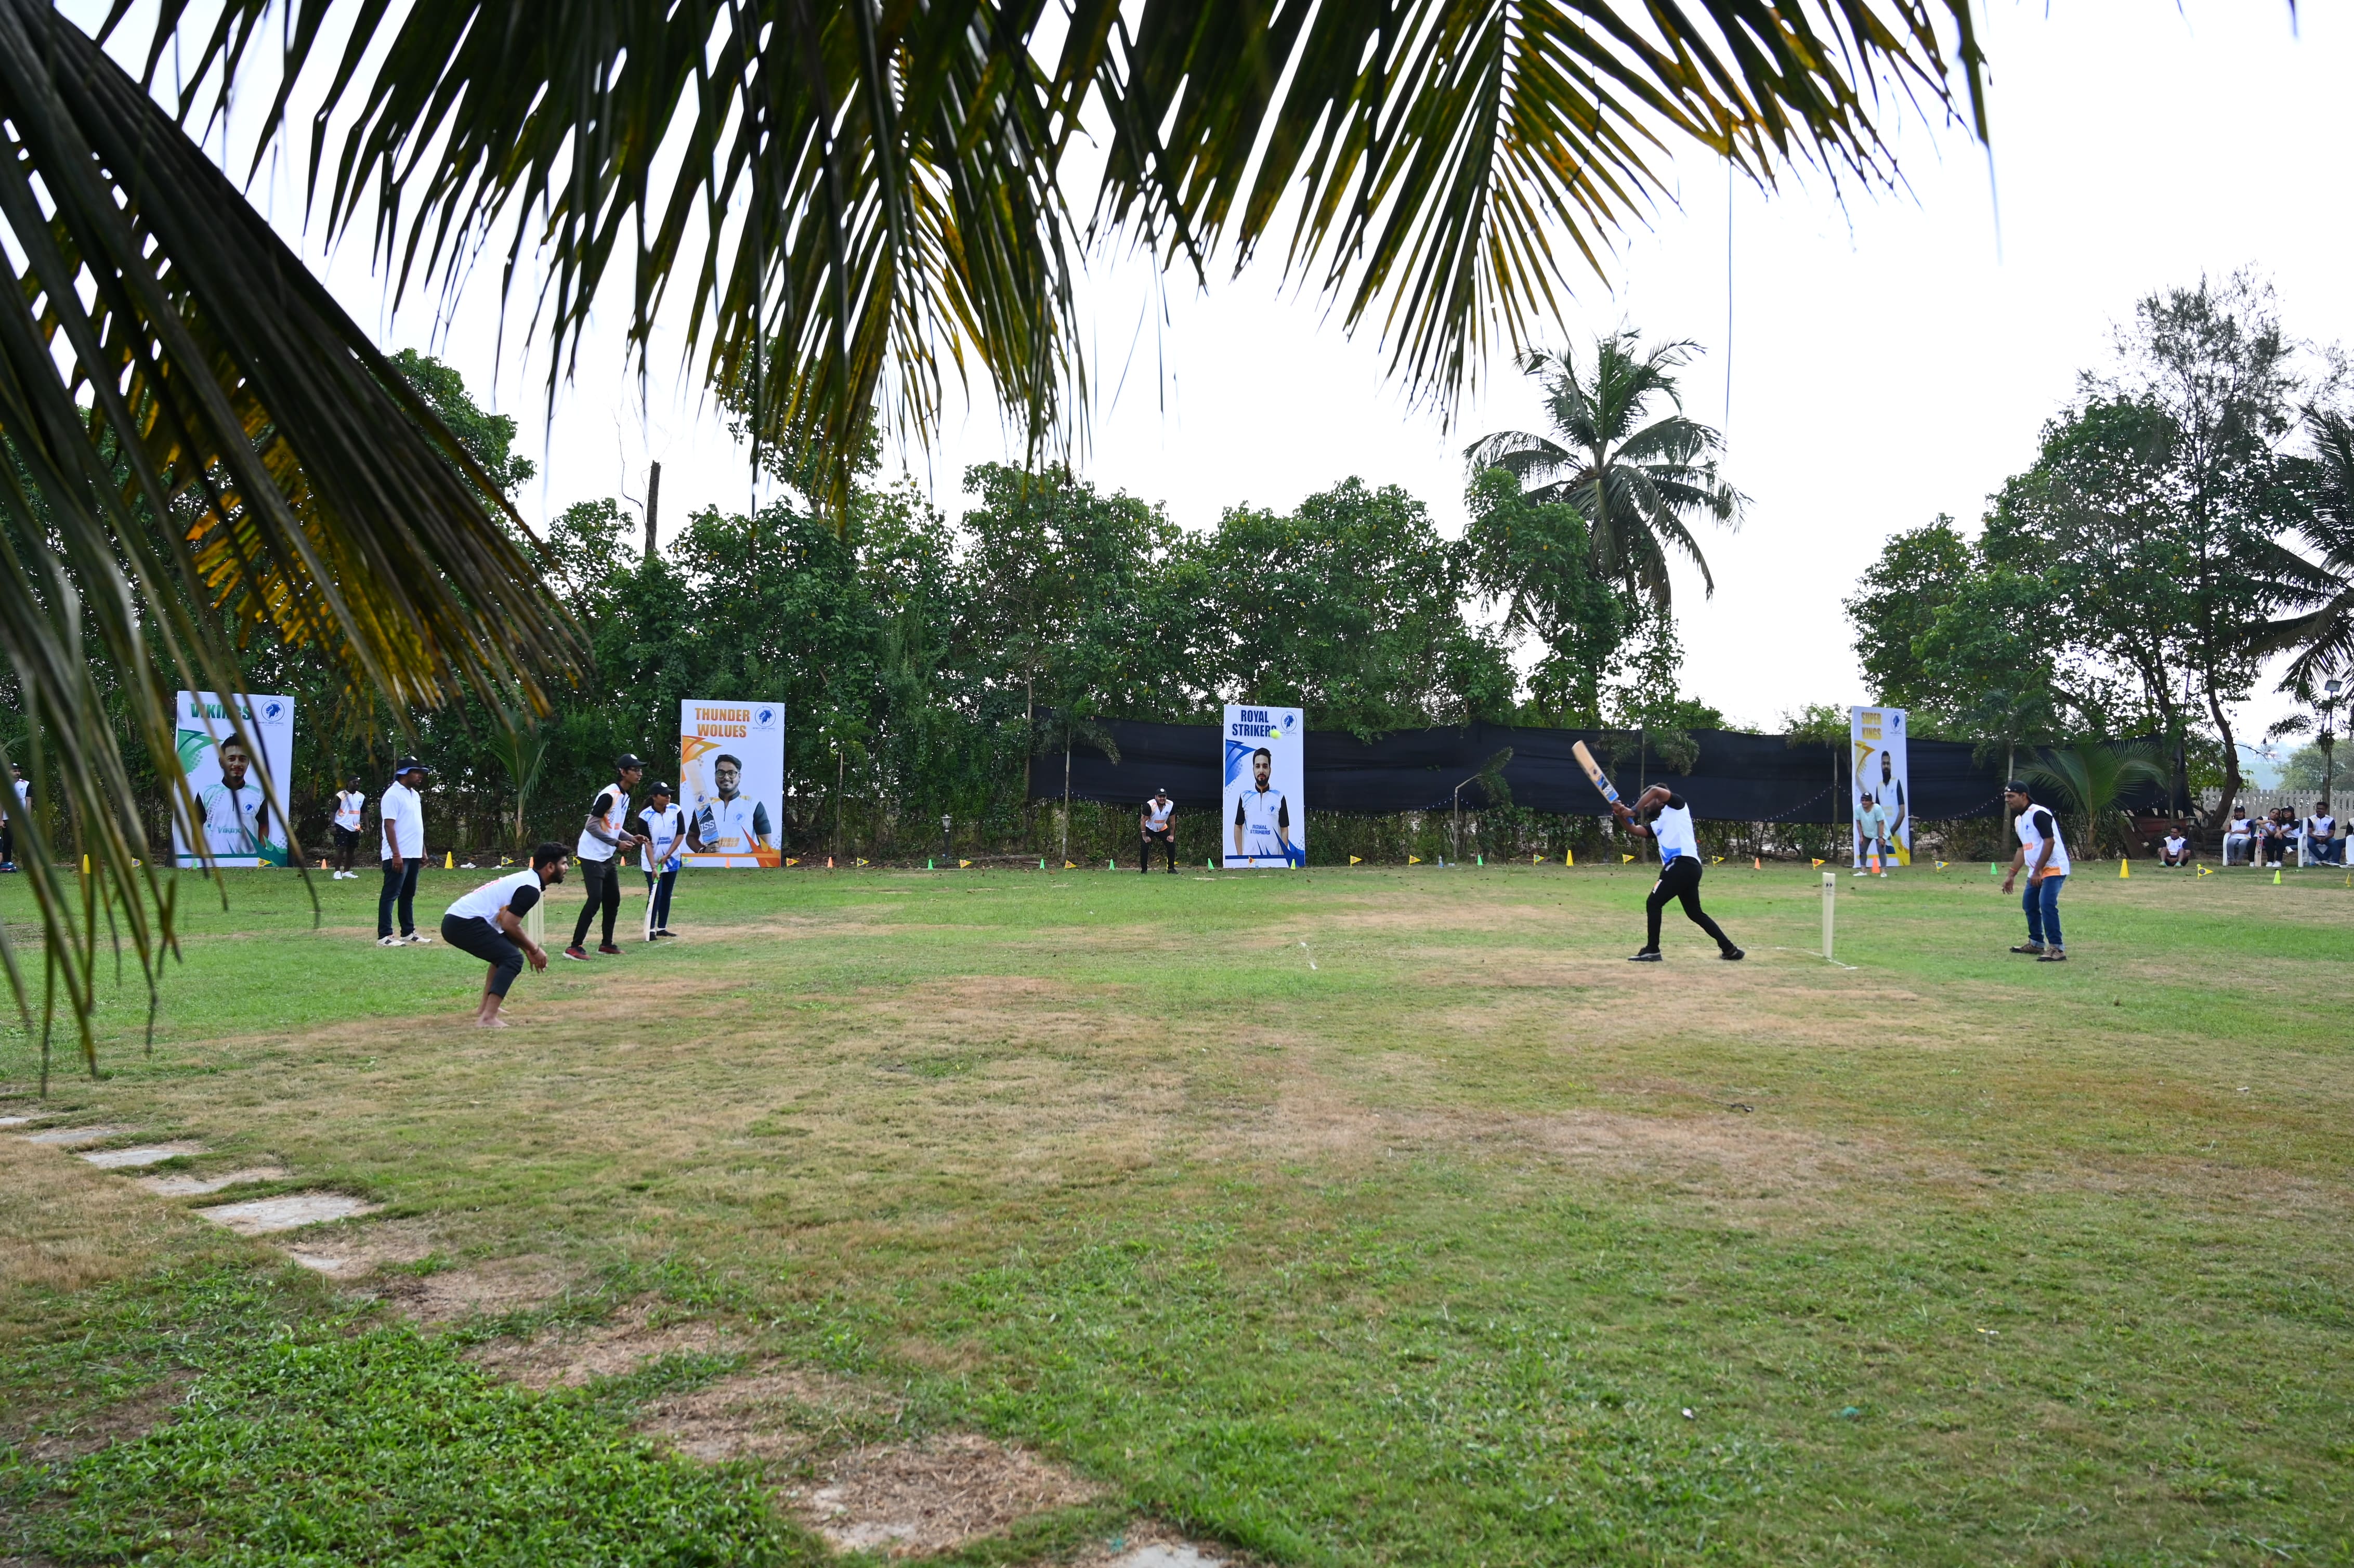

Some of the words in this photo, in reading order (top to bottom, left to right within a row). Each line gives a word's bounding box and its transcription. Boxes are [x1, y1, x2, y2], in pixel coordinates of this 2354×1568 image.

[190, 703, 252, 720] VKINS
[695, 708, 750, 722] THUNDER
[1241, 710, 1269, 723] ROYAL
[1862, 712, 1881, 725] SUPER
[1862, 727, 1881, 740] KINGS
[701, 820, 715, 832] ISS
